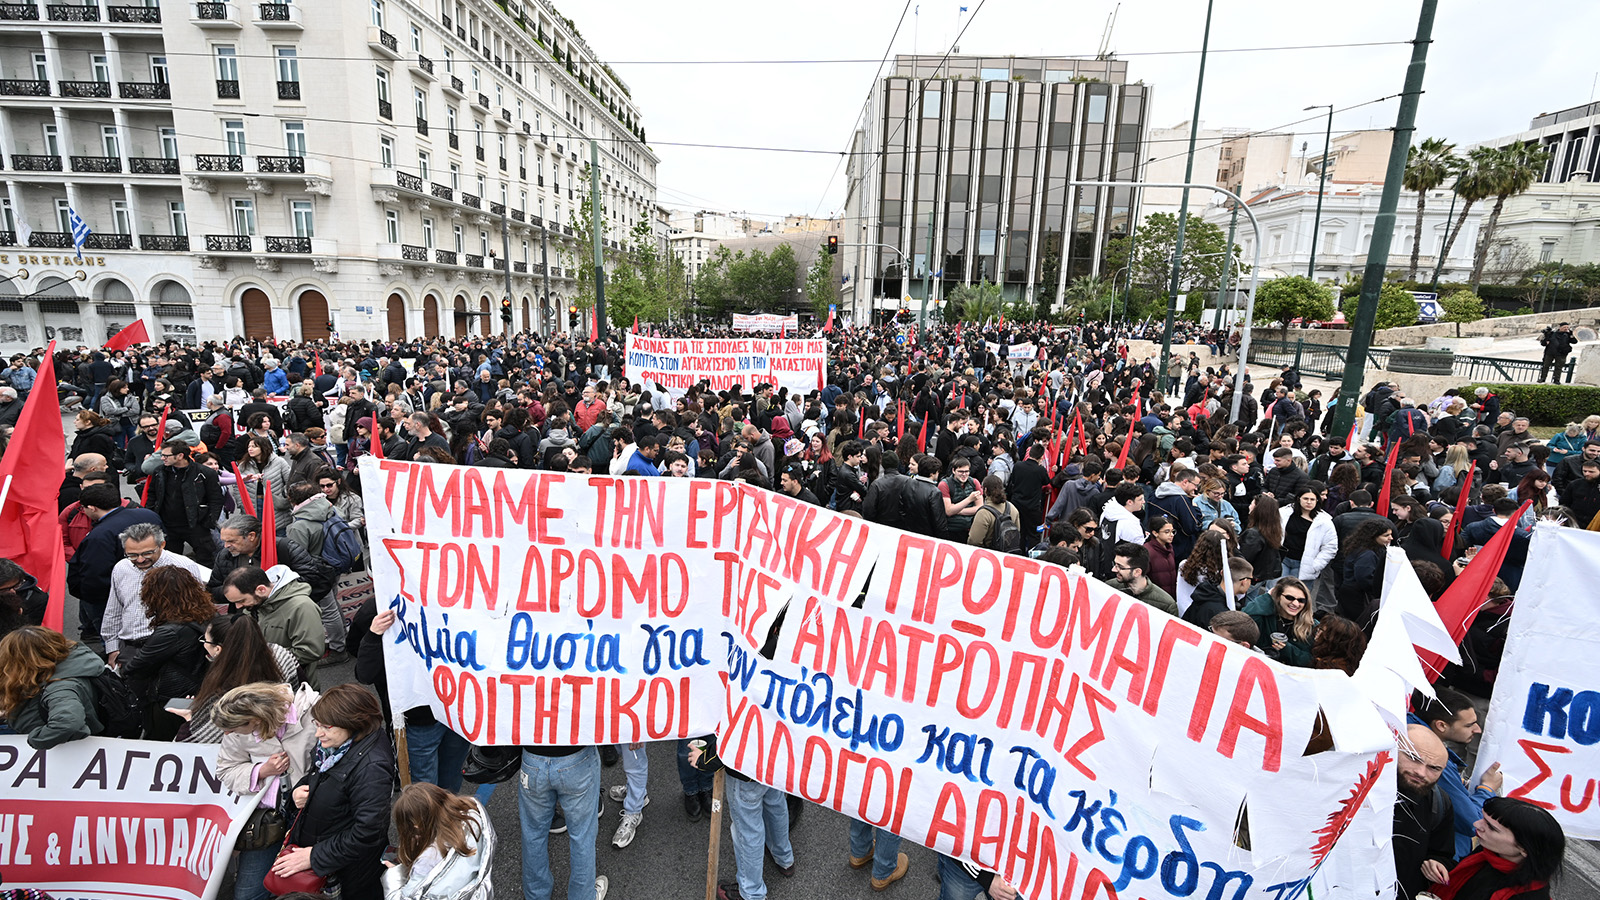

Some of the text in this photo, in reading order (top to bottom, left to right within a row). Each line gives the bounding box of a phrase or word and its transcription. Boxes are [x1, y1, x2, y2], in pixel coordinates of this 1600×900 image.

[17, 254, 106, 266] BRETAGNE
[629, 351, 659, 369] ΚΟΝΤΡΑ
[659, 356, 679, 371] ΣΤΟΝ
[681, 356, 736, 371] ΑΥΤΑΡΧΙΣΜΟ
[738, 356, 750, 370] ΚΑΙ
[752, 356, 767, 369] ΤΗΝ
[632, 337, 823, 354] ΑΓΩΝΑΣ ΓΙΑ ΤΙΣ ΣΠΟΥΔΕΣ ΚΑΙ ΤΗ ΖΩΗ ΜΑΣ
[380, 460, 1284, 773] ΤΙΜΑΜΕ ΤΗΝ ΕΡΓΑΤΙΚΗ ΠΡΩΤΟΜΑΓΙΑ
[382, 538, 1118, 782] ΣΤΟΝ ΔΡΟΜΟ ΤΗΣ ΑΝΑΤΡΟΠΗΣ
[506, 612, 627, 674] θυσία
[641, 624, 711, 676] για
[761, 666, 904, 752] πόλεμο
[916, 725, 995, 787] και
[1010, 746, 1056, 820] τα
[72, 748, 240, 804] ΑΓΩΝ
[433, 665, 690, 745] ΦΟΙΤΗΤΙΚΟΙ
[715, 671, 913, 836] ΥΛΛΟΓΟΙ
[1507, 739, 1600, 814] Συ
[45, 832, 61, 866] &
